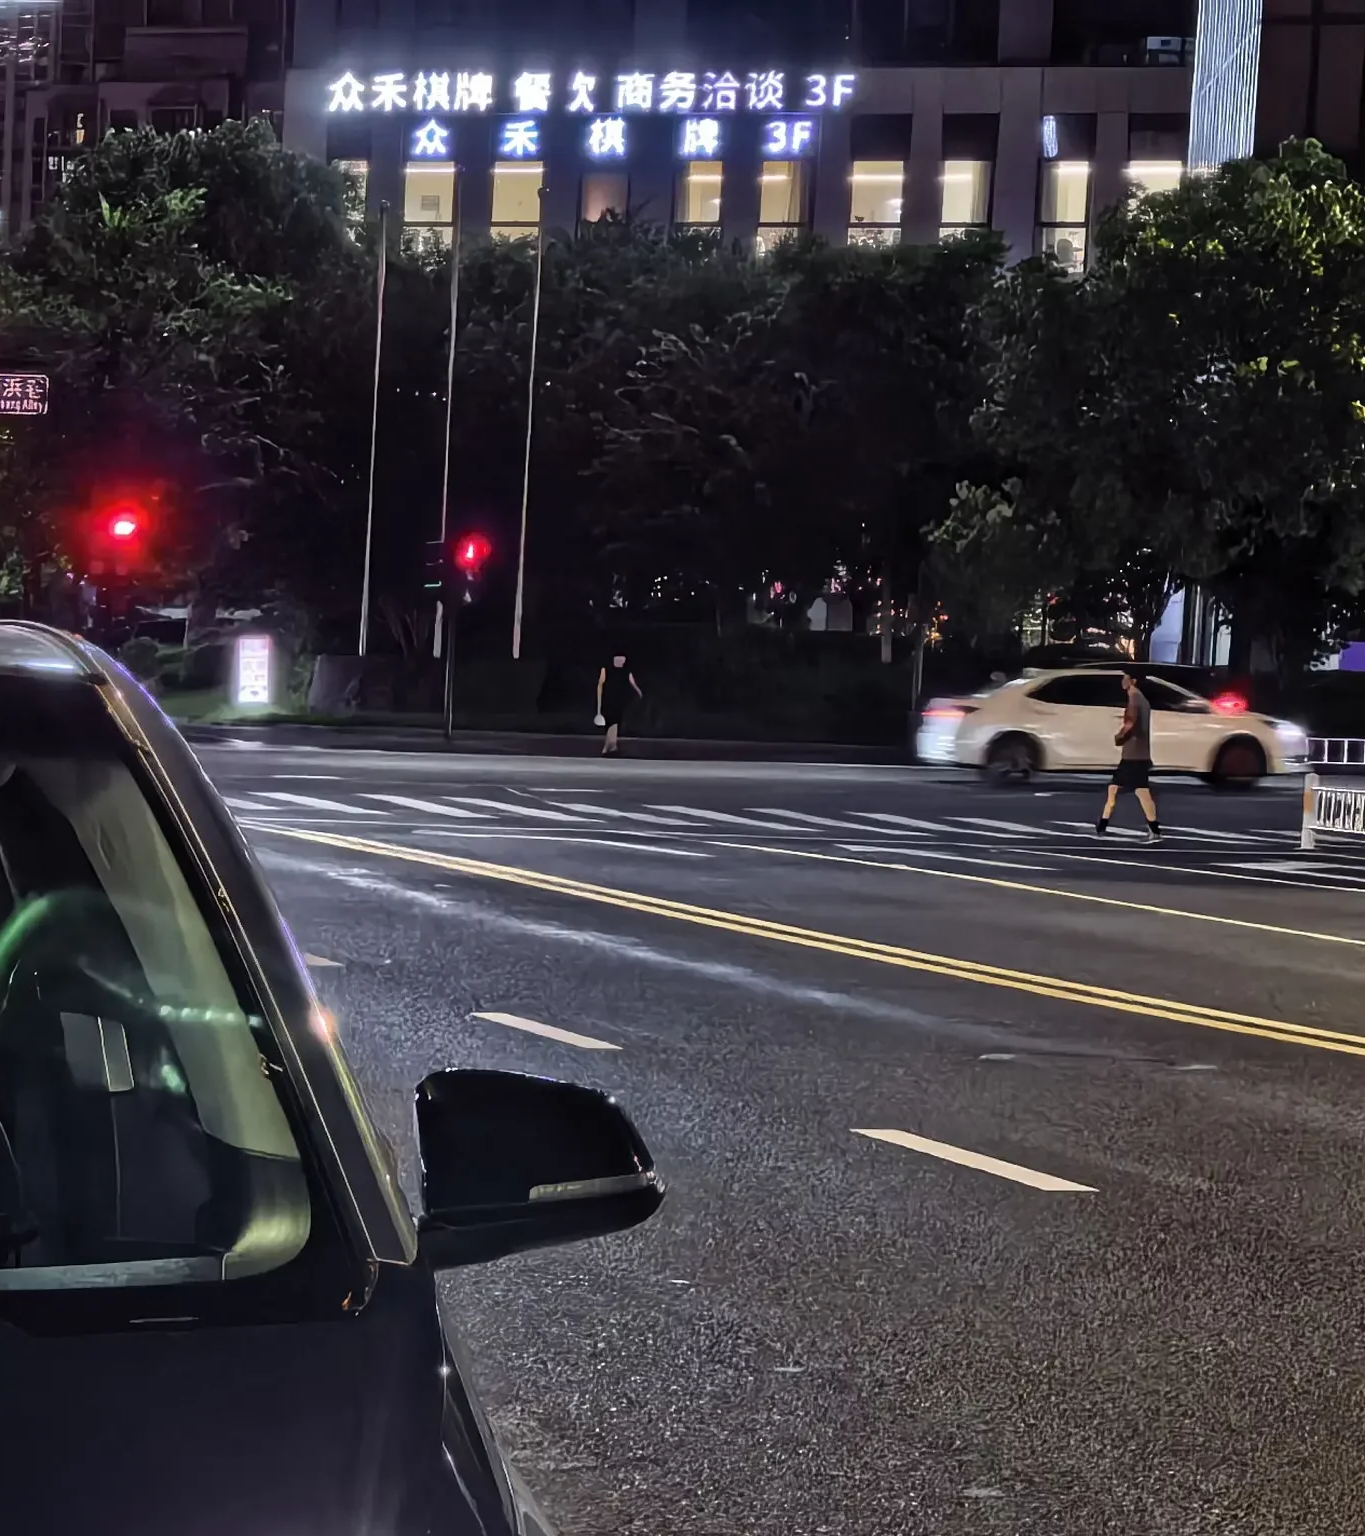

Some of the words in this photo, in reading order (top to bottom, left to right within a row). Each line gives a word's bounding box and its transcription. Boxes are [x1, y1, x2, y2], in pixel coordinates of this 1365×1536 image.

[328, 71, 493, 113] 众禾棋牌
[616, 70, 786, 113] 商务洽谈
[805, 73, 856, 108] 3F
[764, 120, 813, 154] 3F
